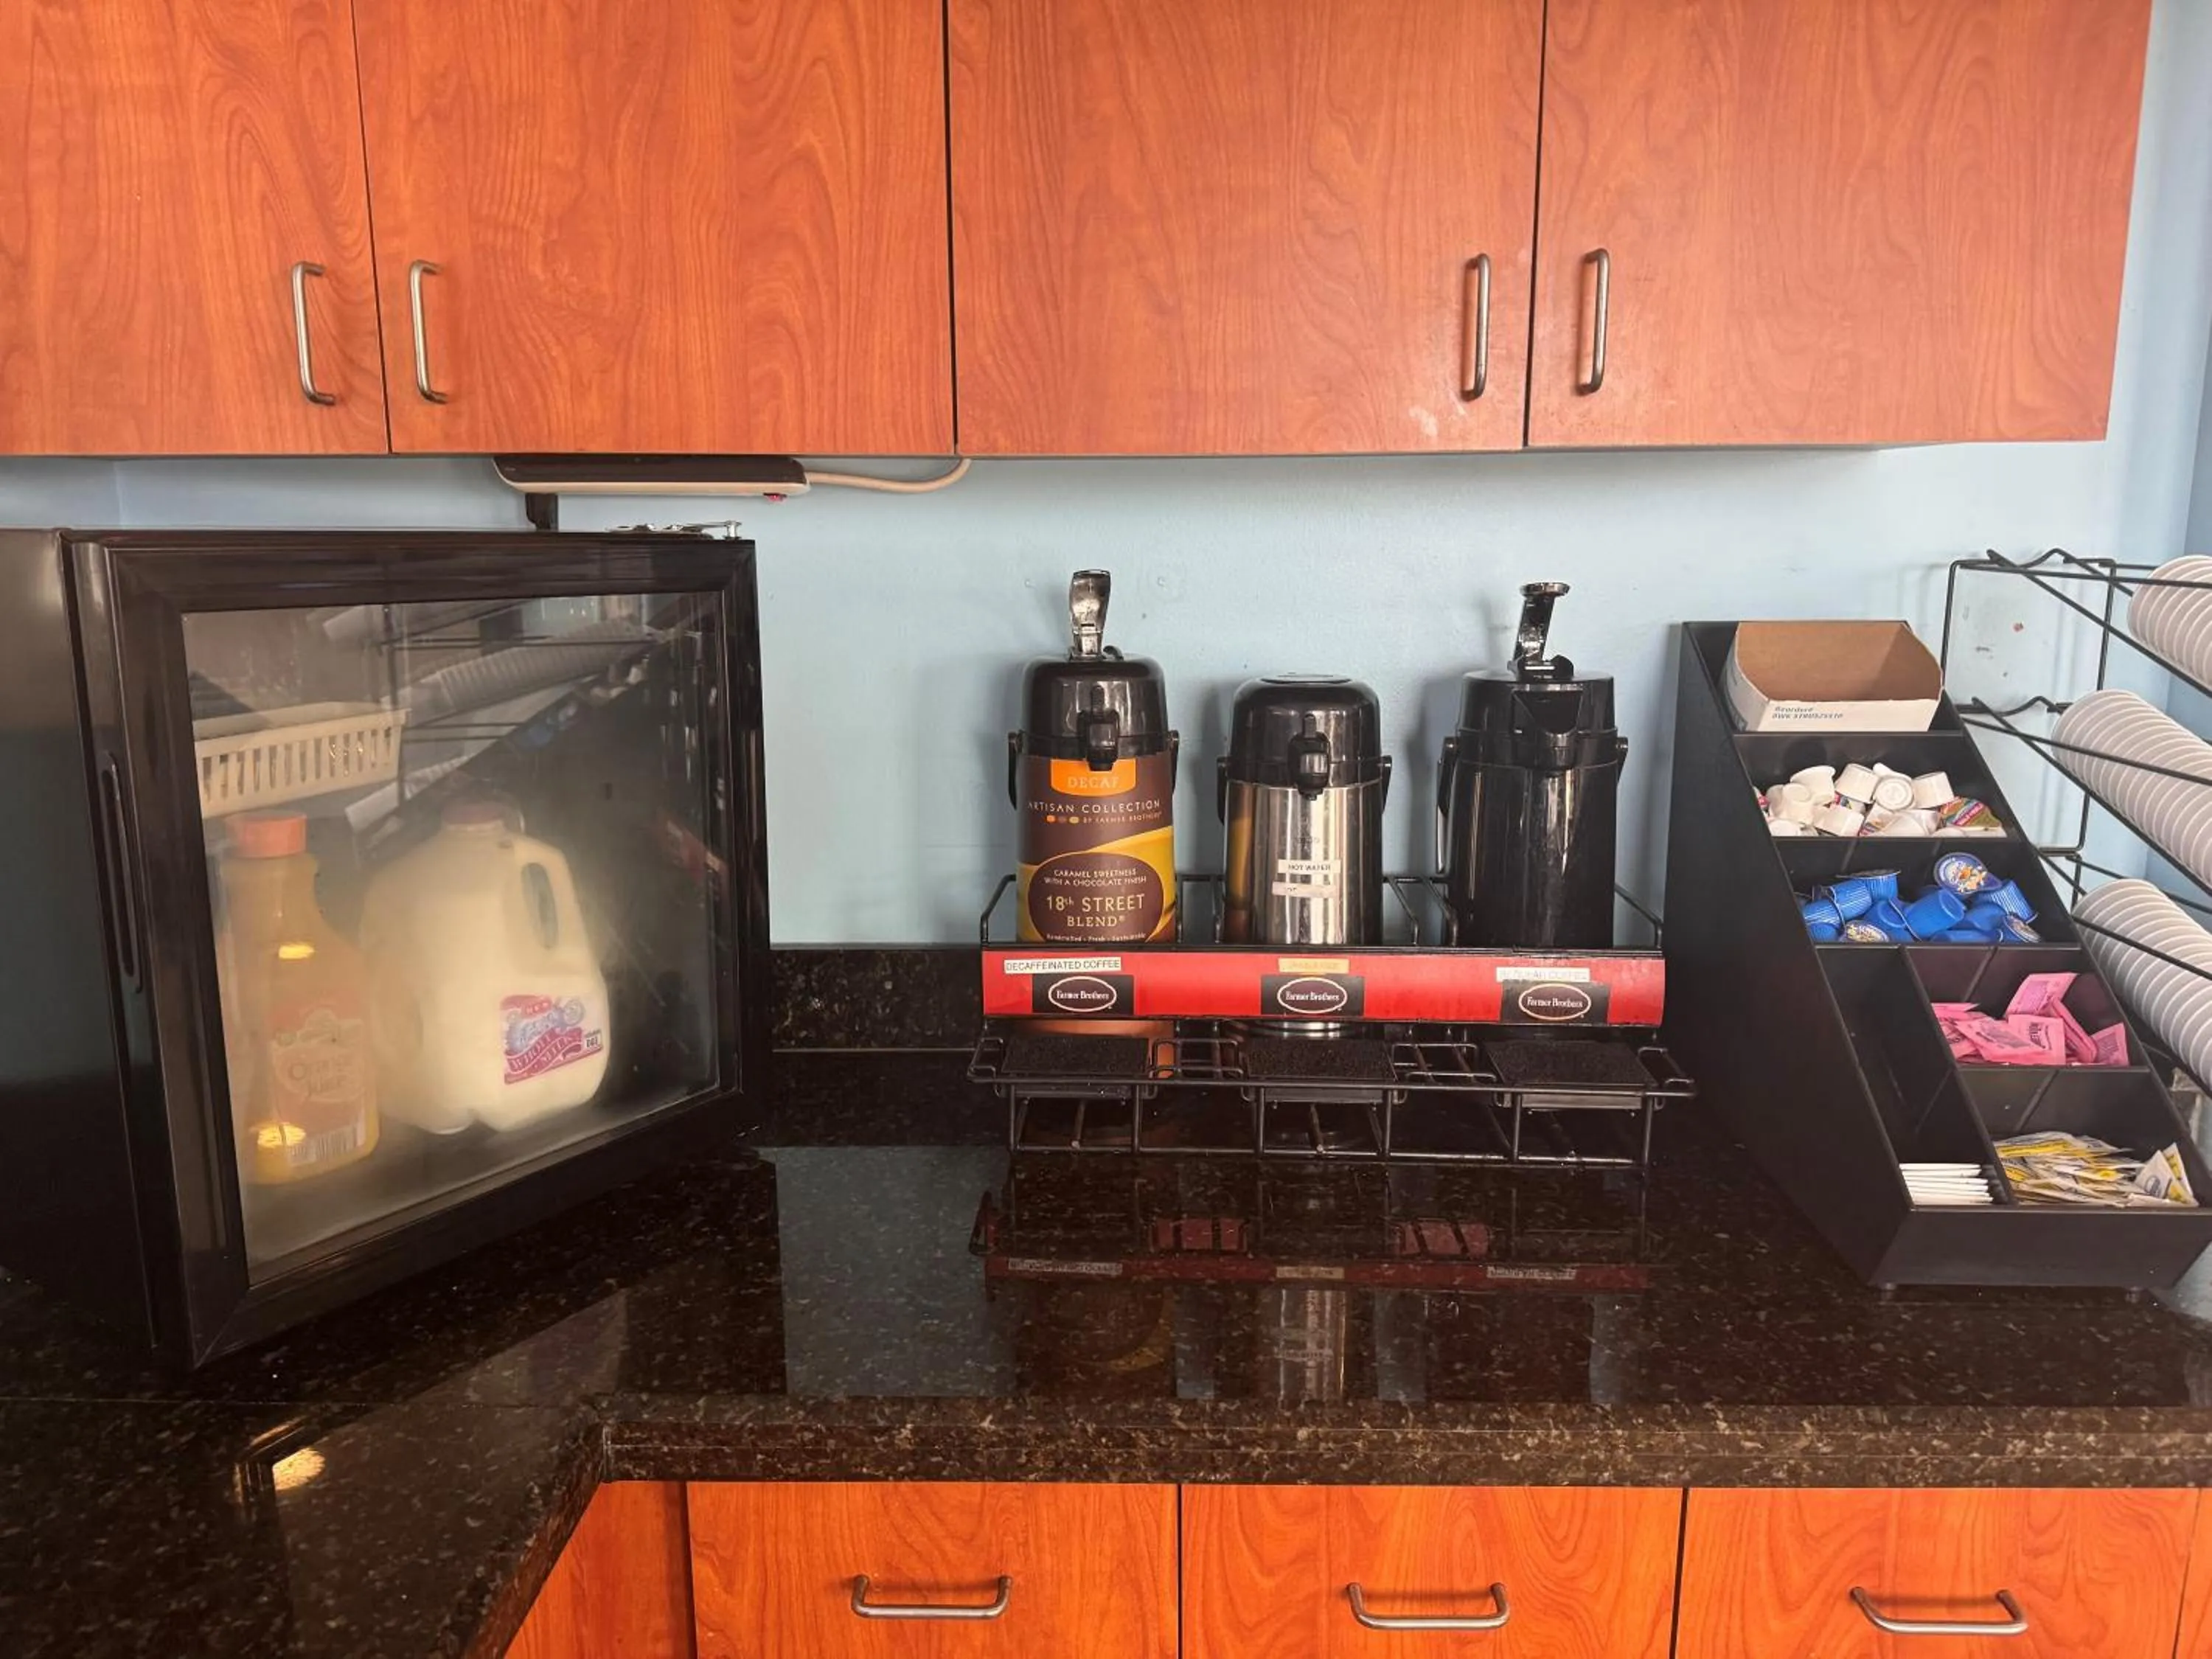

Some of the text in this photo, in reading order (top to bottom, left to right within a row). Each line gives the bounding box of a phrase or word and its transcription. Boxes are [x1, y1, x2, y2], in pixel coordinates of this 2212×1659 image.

[1068, 776, 1119, 789] DECAF
[1082, 799, 1161, 814] COLLECTION
[1054, 868, 1136, 877] CARAMEL SWEETNESS
[1074, 879, 1121, 887] CHOCOLATE
[1082, 894, 1145, 912] STREET
[1006, 959, 1120, 971] DECAFFEINATED COFFEE
